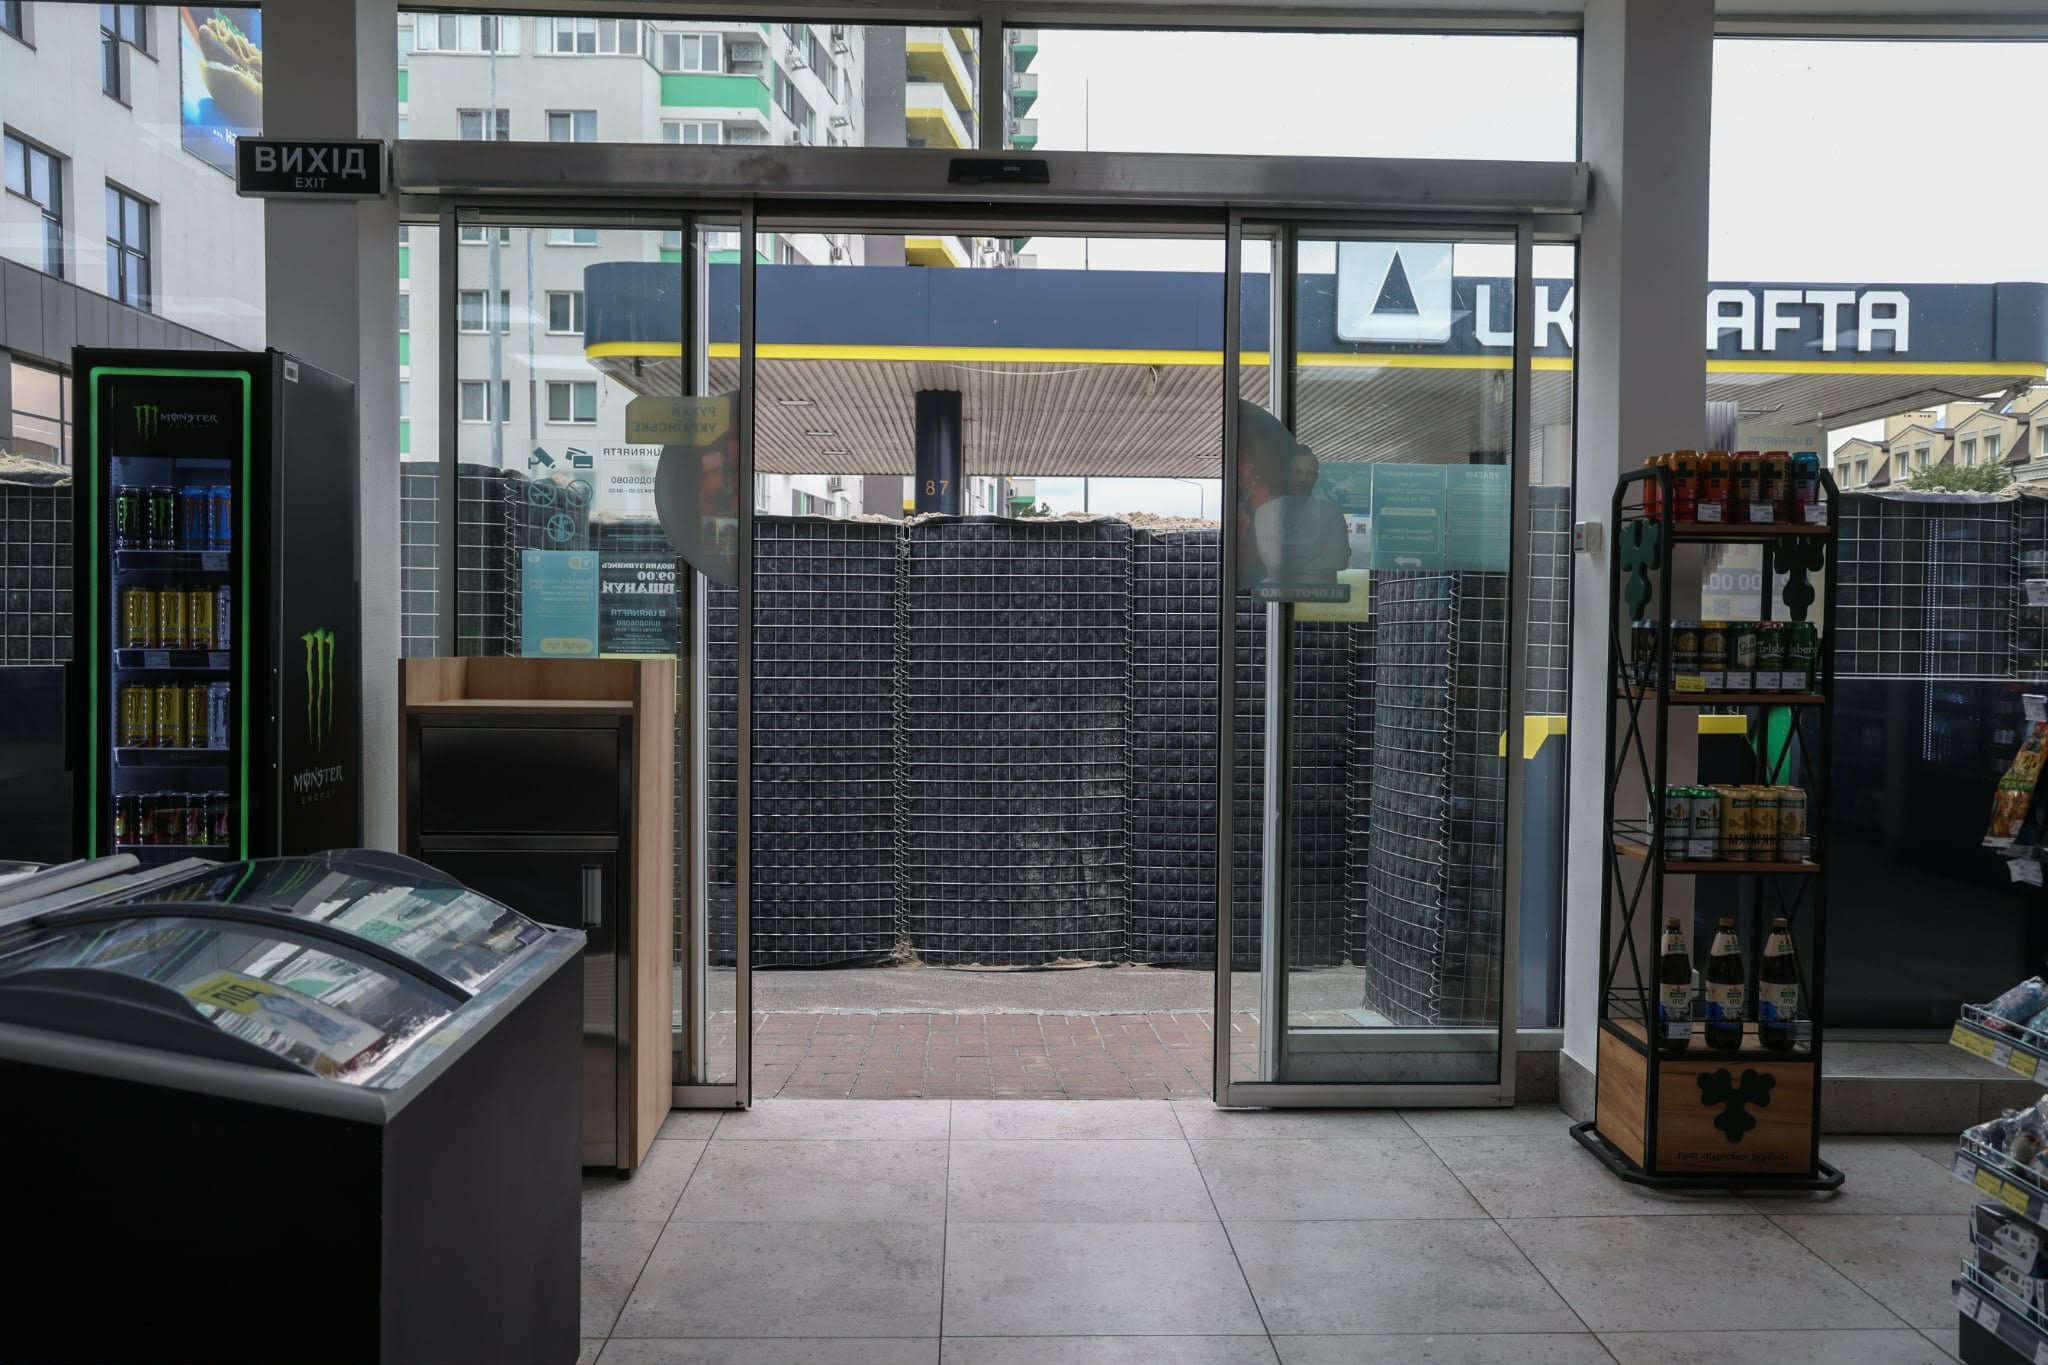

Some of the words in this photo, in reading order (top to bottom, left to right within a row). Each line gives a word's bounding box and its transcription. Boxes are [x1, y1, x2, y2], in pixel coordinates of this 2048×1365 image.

[255, 146, 366, 179] ВИХІД
[295, 177, 327, 188] EXIT
[1476, 284, 1909, 352] UKAFTA
[160, 411, 218, 424] MONSTER
[925, 479, 950, 496] 87
[293, 764, 343, 793] MONSTER
